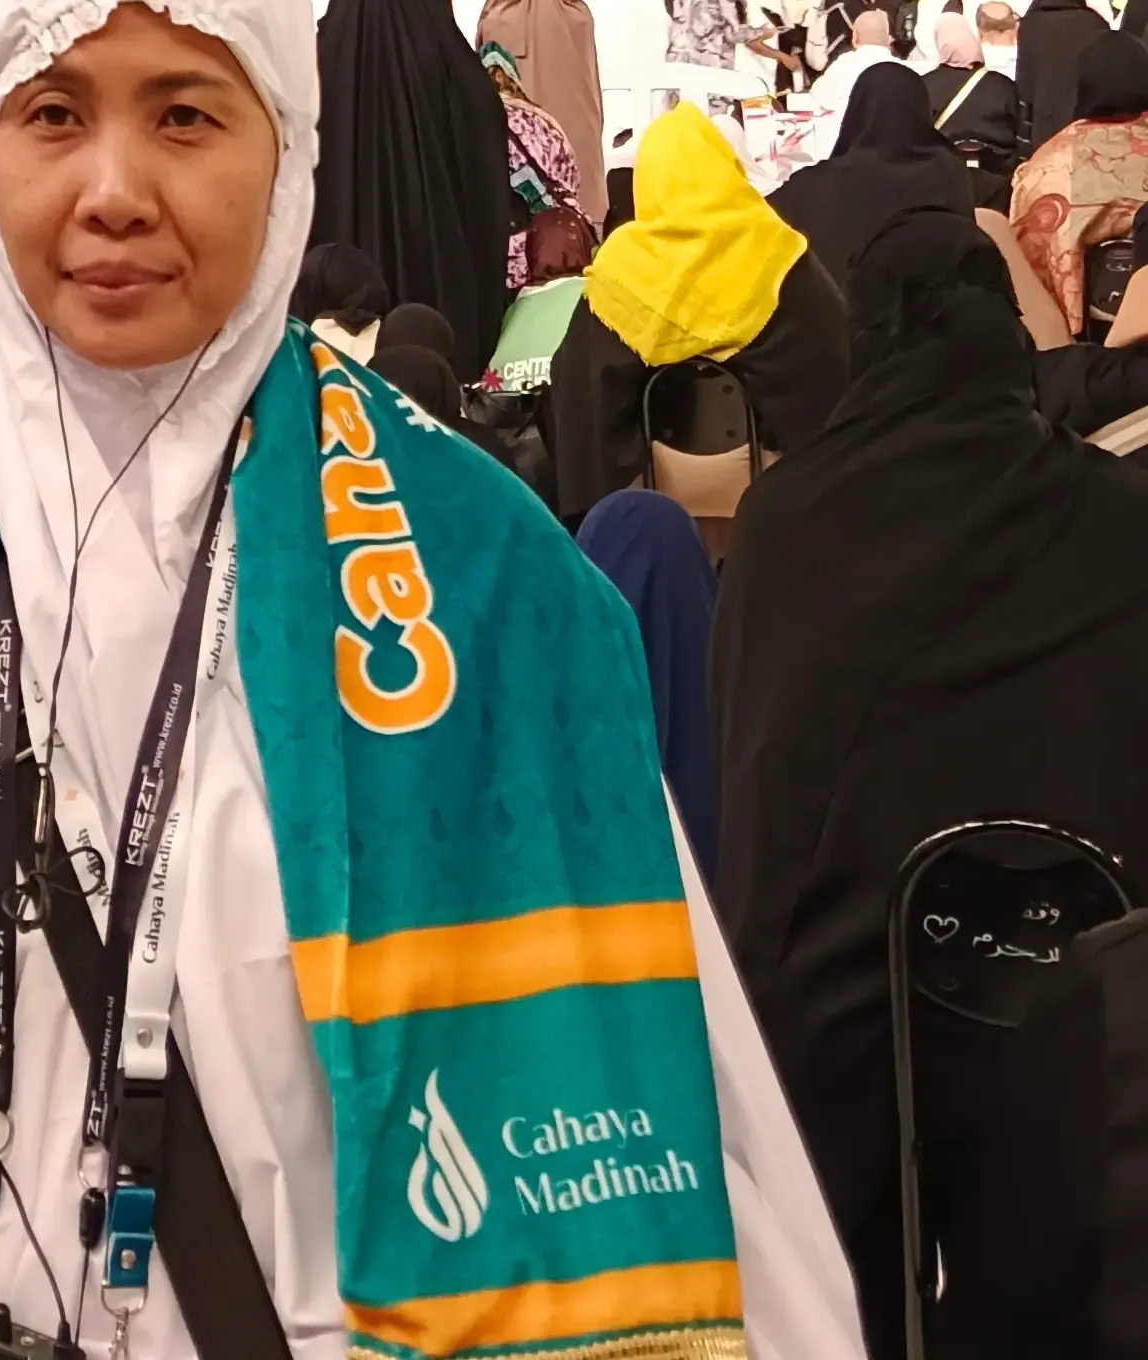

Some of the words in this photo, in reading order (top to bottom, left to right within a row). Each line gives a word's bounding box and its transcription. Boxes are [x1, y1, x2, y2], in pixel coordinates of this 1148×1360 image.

[142, 895, 165, 965] Cahaya
[502, 1107, 654, 1160] Cahaya
[513, 1148, 700, 1217] Madinah
